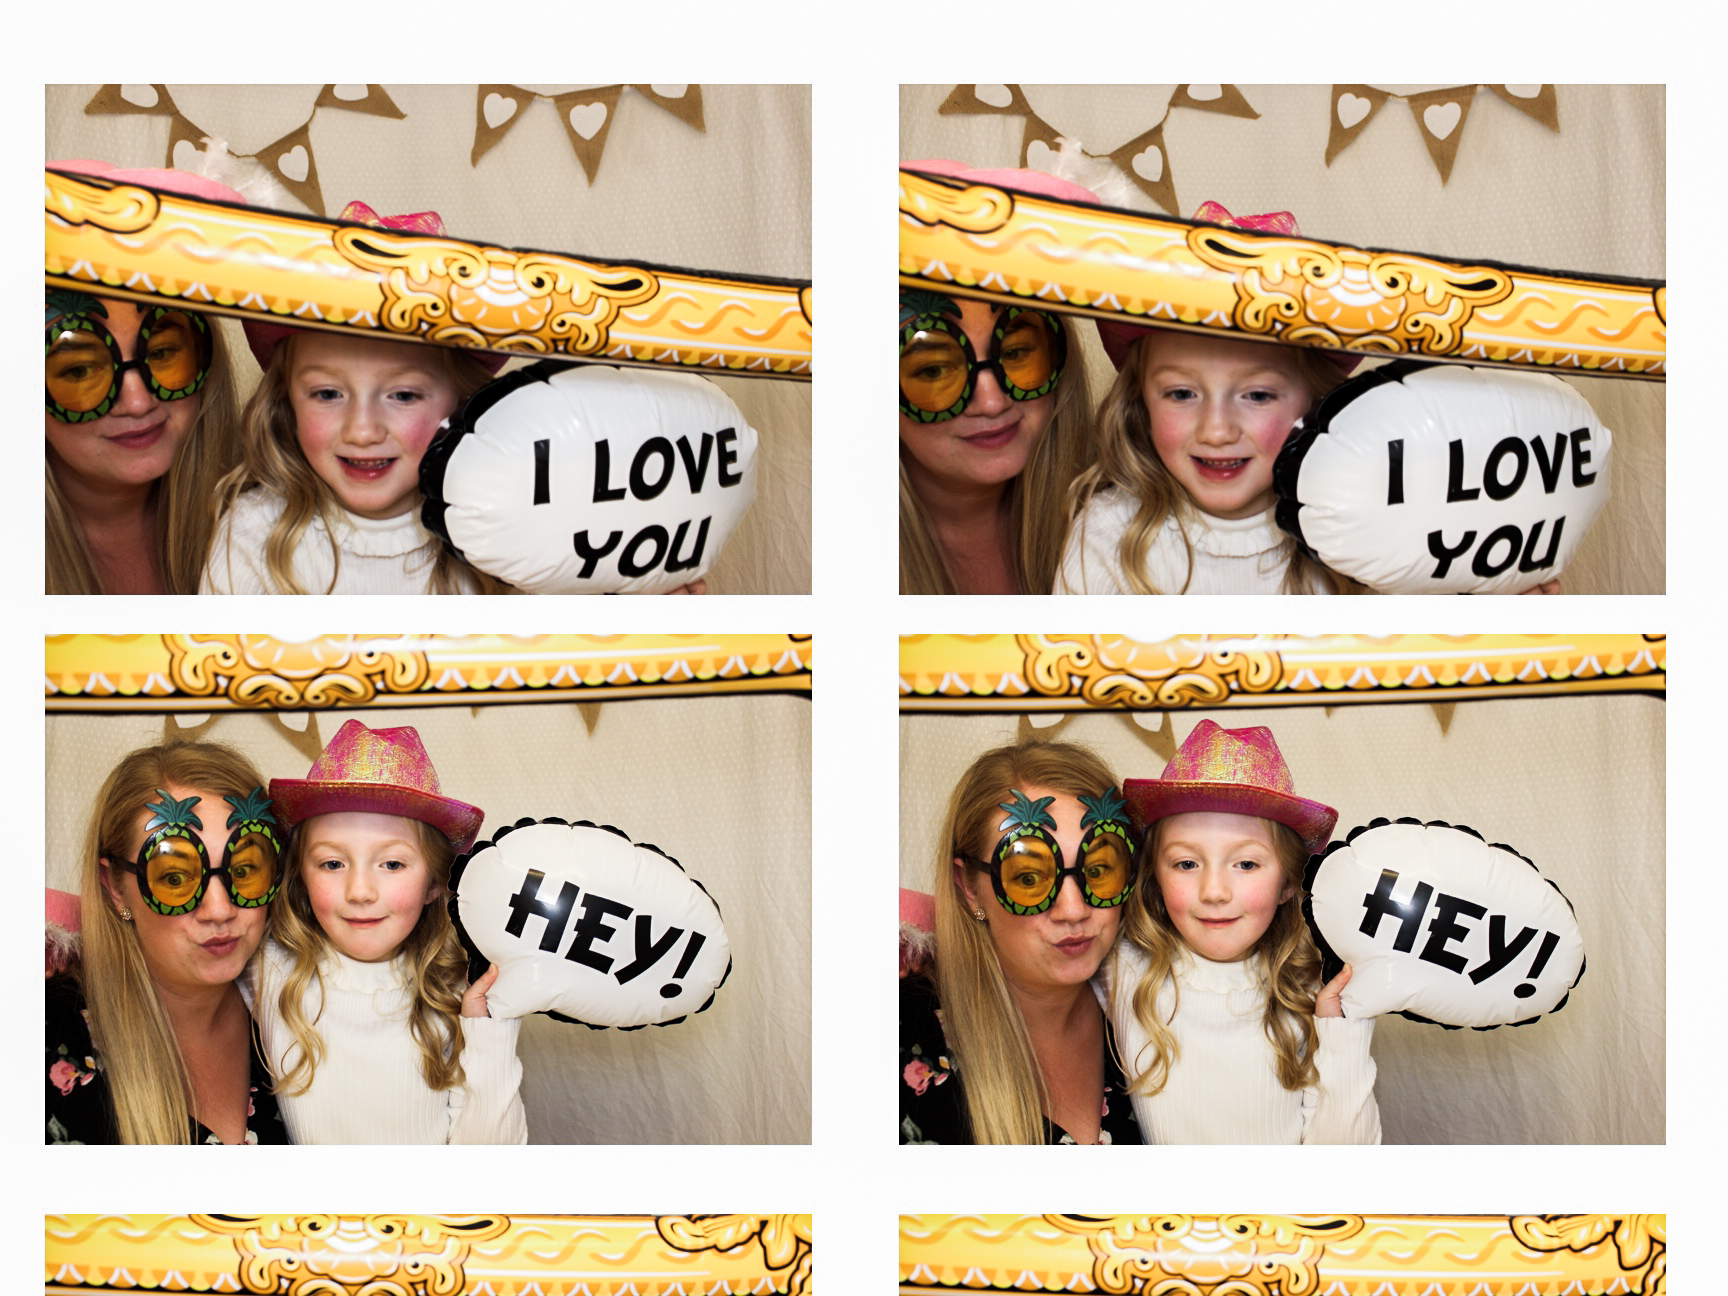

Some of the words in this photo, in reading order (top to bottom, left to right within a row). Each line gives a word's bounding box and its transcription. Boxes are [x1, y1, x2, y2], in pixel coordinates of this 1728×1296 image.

[532, 438, 552, 507] I
[592, 427, 743, 503] LOVE
[1386, 438, 1406, 507] I
[1446, 427, 1597, 503] LOVE
[573, 514, 712, 580] YOU
[1427, 514, 1566, 580] YOU
[504, 868, 707, 999] HEY!
[1358, 868, 1561, 999] HEY!
